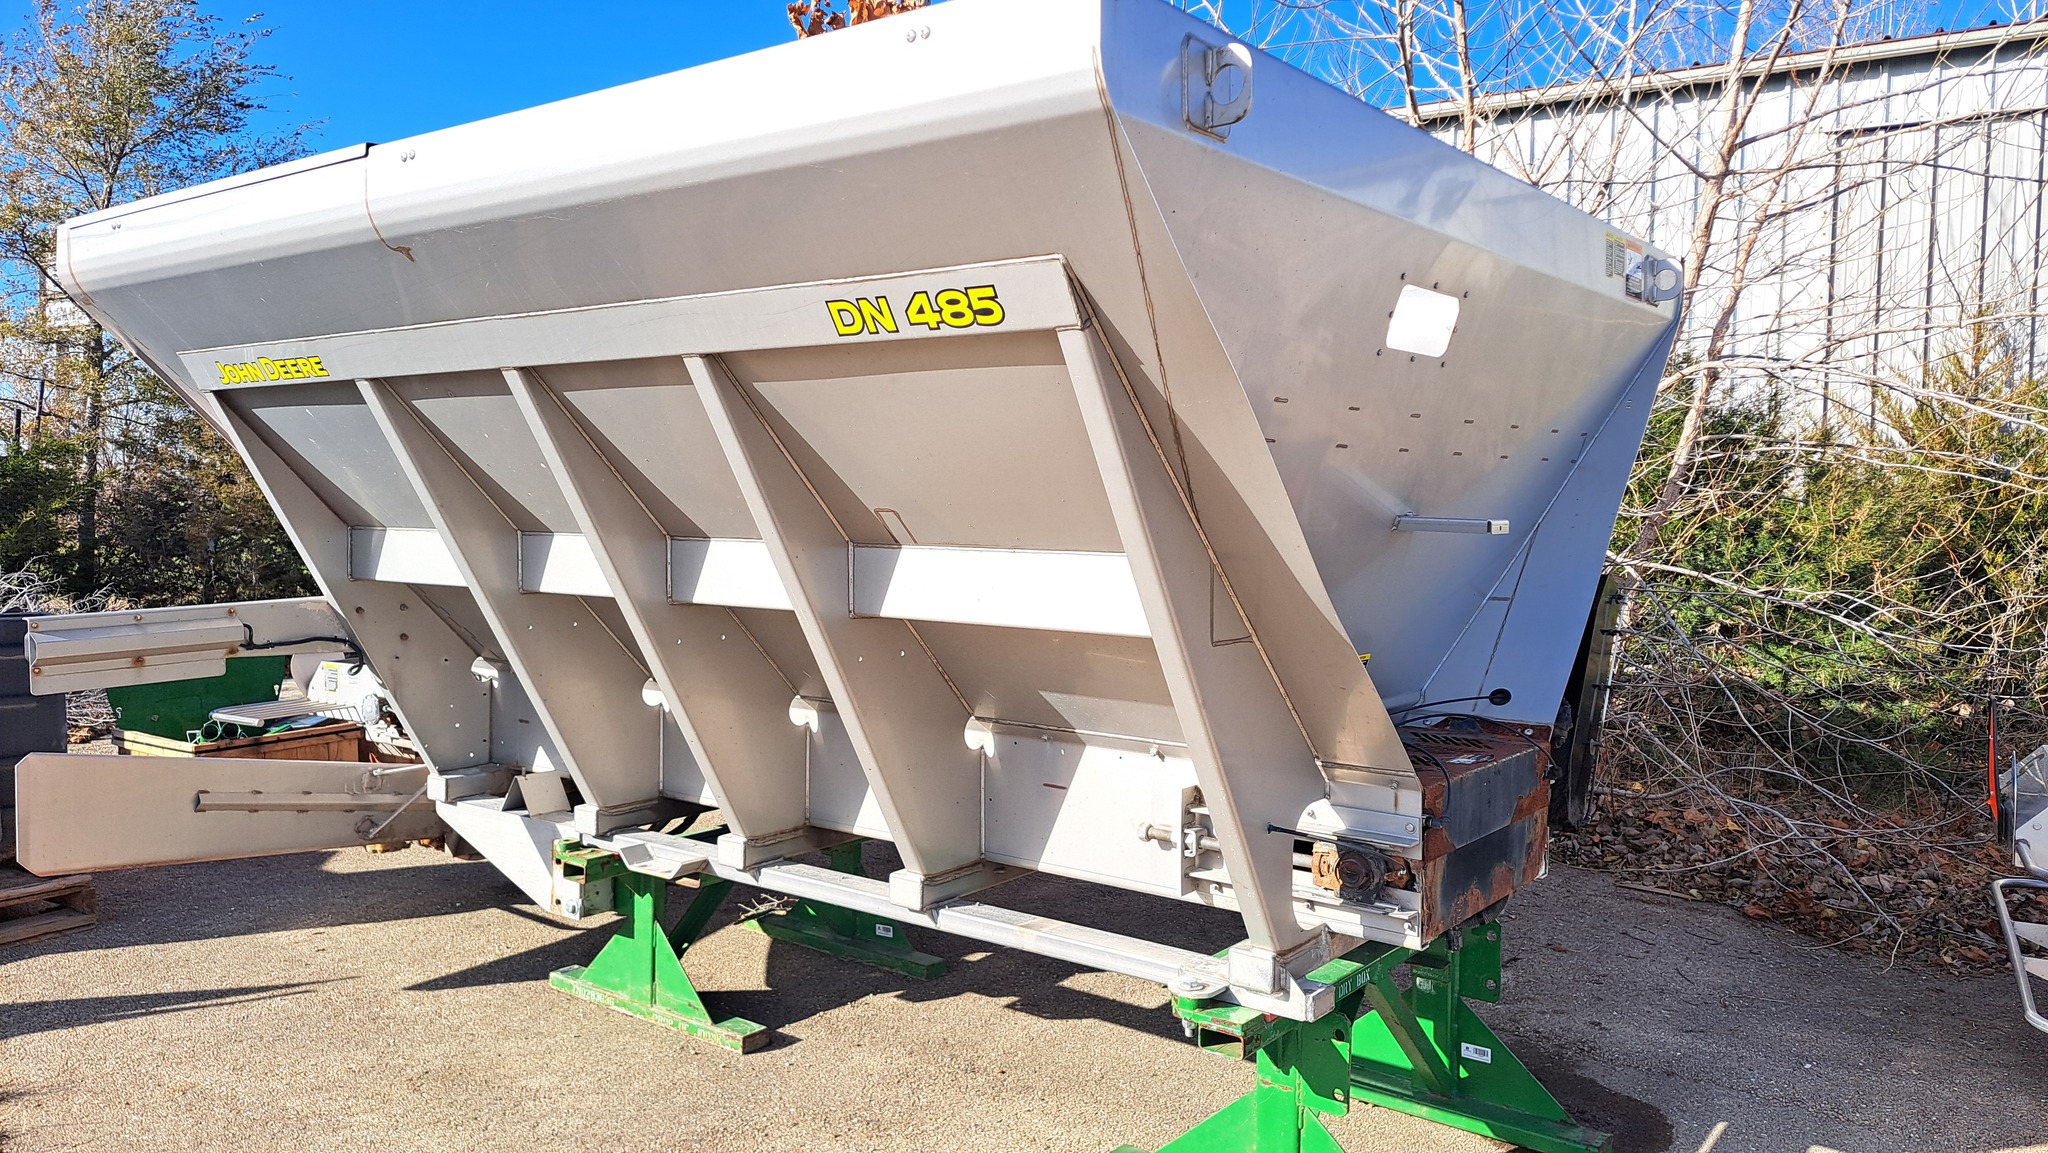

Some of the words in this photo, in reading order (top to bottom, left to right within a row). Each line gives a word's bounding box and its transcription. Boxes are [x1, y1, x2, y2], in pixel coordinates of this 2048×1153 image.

[825, 295, 899, 337] DN
[904, 284, 1005, 332] 485
[215, 361, 267, 385] JOHN
[257, 356, 330, 381] DEERE
[1338, 979, 1353, 999] DRY
[1356, 968, 1371, 987] BOX
